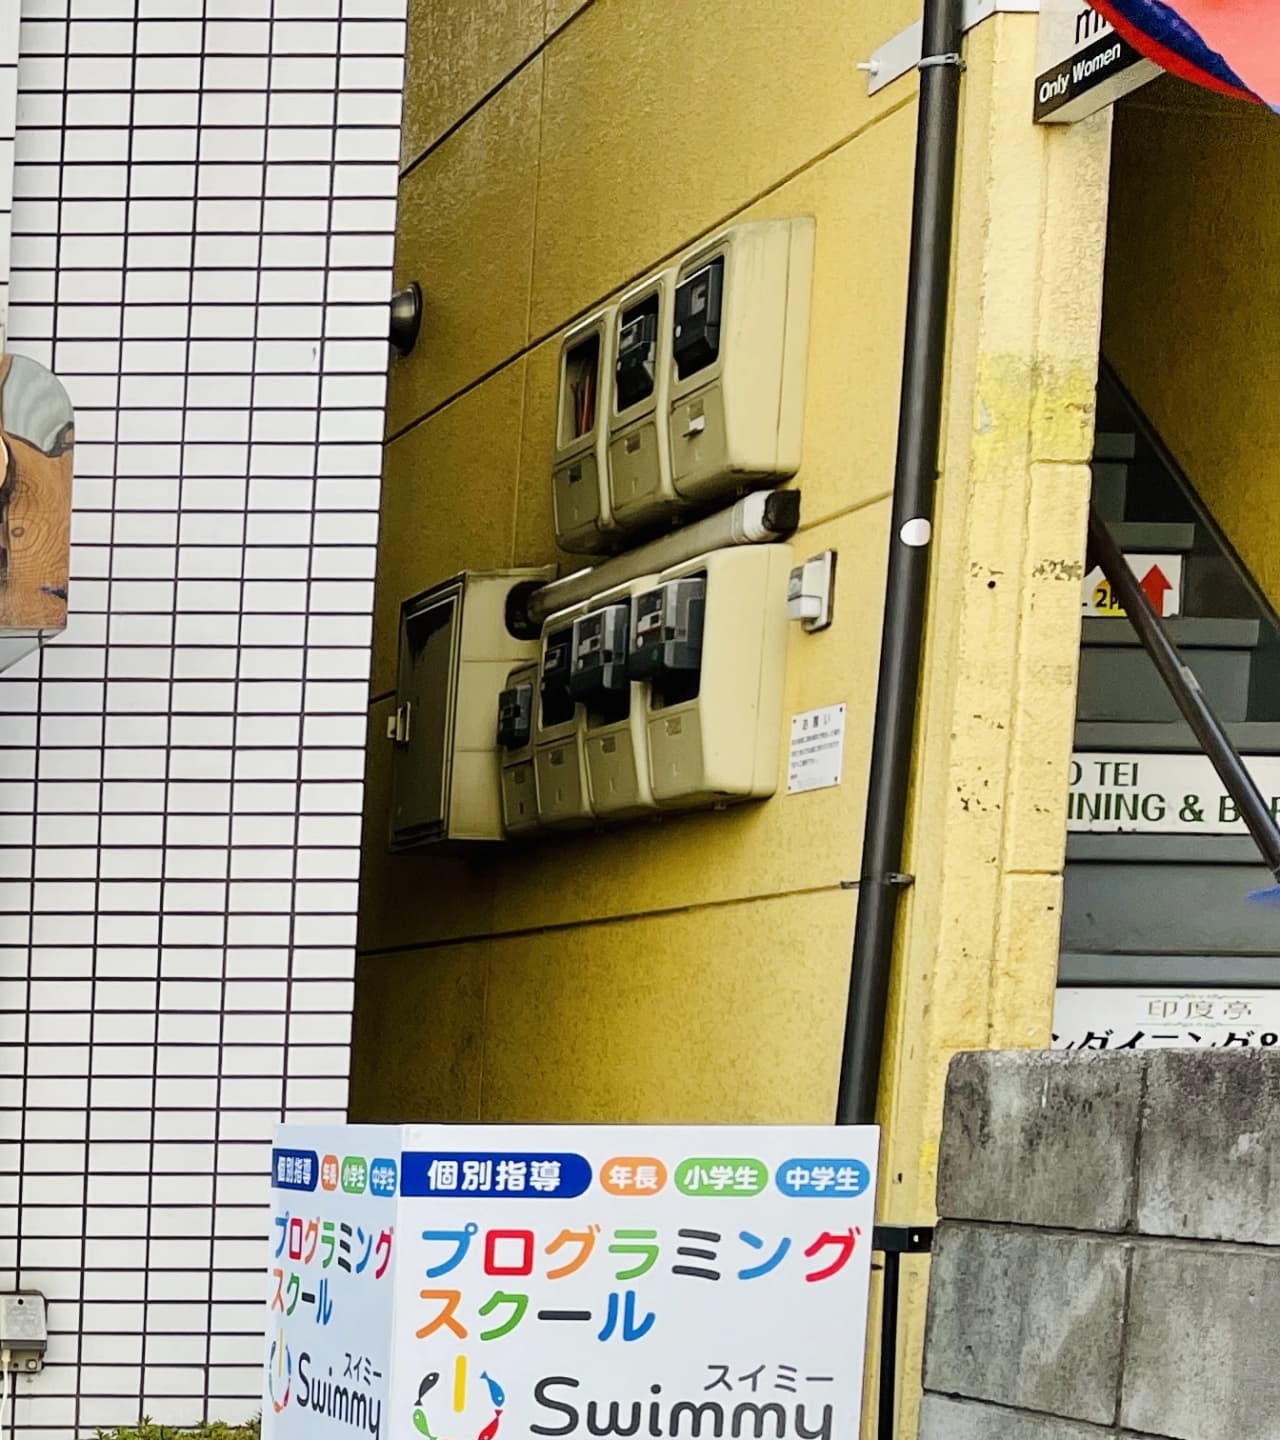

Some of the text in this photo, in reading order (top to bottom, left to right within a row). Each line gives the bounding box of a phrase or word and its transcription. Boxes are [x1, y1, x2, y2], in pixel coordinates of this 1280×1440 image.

[1040, 43, 1121, 104] Only Women
[1094, 762, 1138, 787] TEI
[1068, 792, 1165, 821] INING
[1179, 794, 1204, 822] &
[1148, 999, 1252, 1020] 印度亭
[427, 1159, 861, 1192] 個別指導 年長 小学生 中学生
[274, 1210, 395, 1279] プログラミング
[421, 1221, 861, 1282] プログラミング
[272, 1268, 333, 1325] スクール
[416, 1289, 656, 1342] スクール
[343, 1352, 382, 1385] スイミー
[704, 1363, 835, 1393] スイミー
